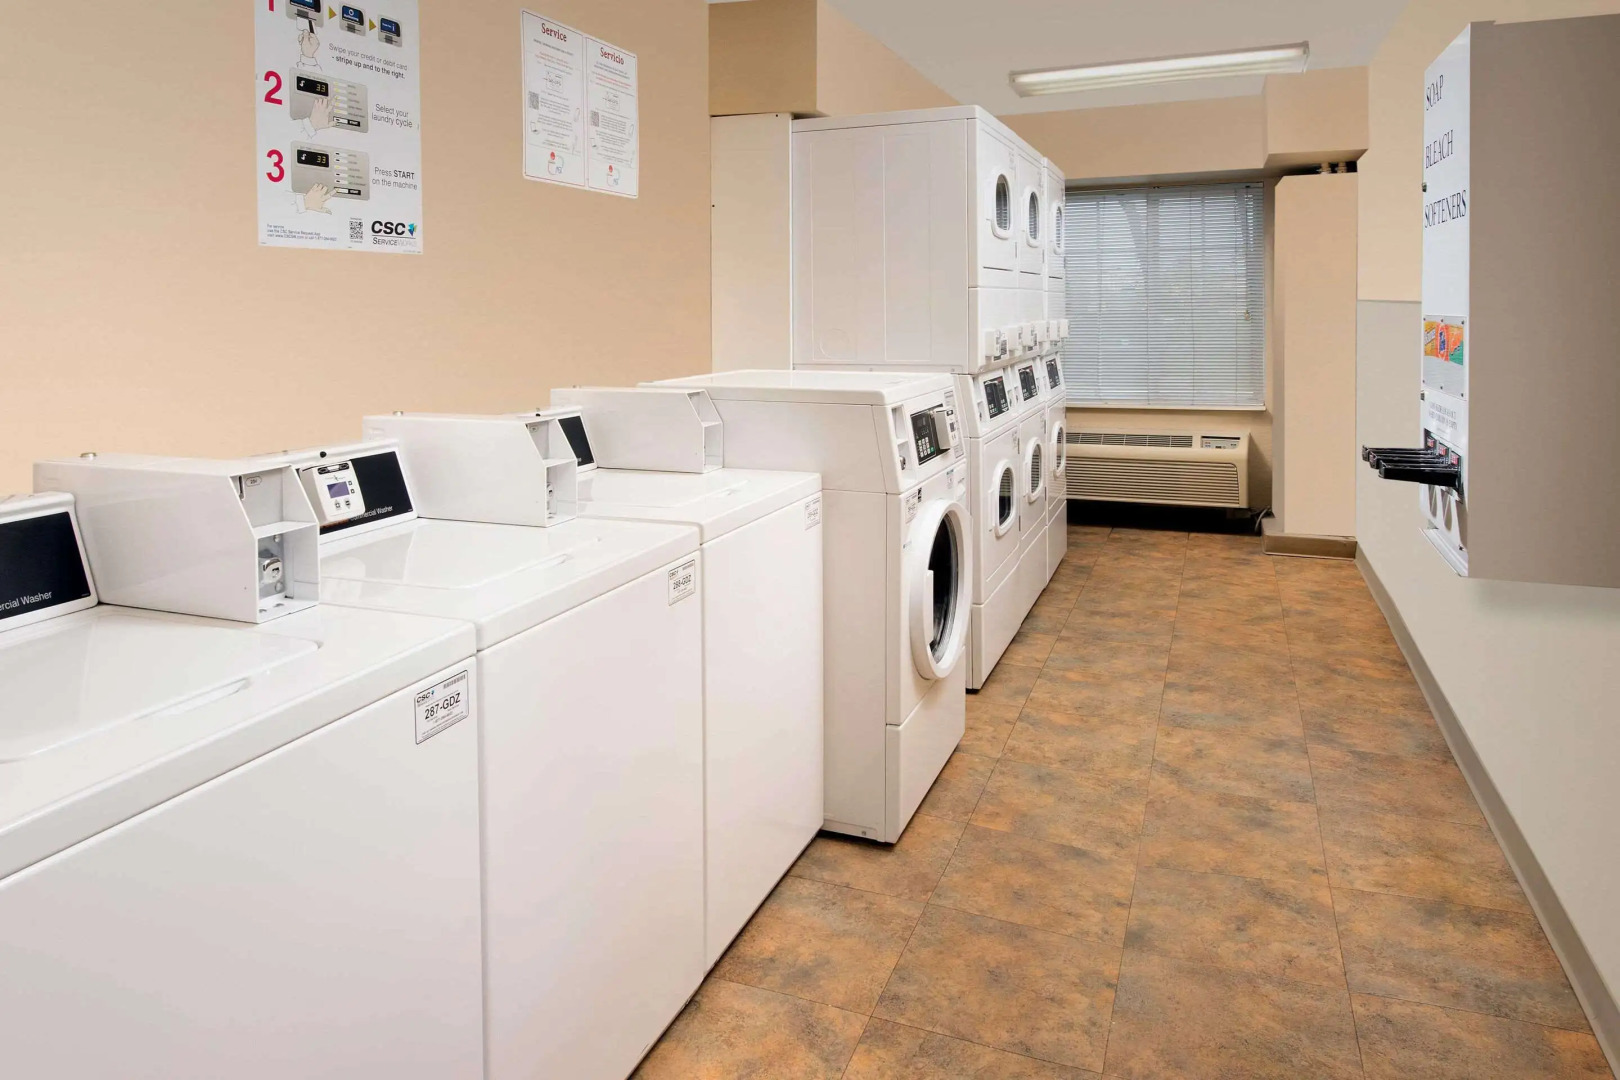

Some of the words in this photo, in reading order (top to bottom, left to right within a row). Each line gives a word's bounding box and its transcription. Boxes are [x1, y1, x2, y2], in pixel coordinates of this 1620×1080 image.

[541, 22, 567, 42] Service
[348, 48, 360, 57] your
[600, 47, 624, 65] Servicio
[336, 56, 352, 65] stripe
[264, 70, 283, 105] 2
[1426, 74, 1444, 111] SOAP
[376, 103, 395, 115] Select
[396, 110, 408, 118] your
[372, 112, 394, 126] laundry
[396, 118, 412, 128] cycle
[1426, 129, 1454, 169] BLEACH
[266, 148, 285, 182] 3
[374, 167, 392, 176] Press
[394, 170, 415, 180] START
[382, 178, 392, 186] the
[393, 181, 417, 190] machine
[1424, 190, 1467, 229] SOFTENERS
[371, 220, 406, 235] CSC
[376, 506, 393, 514] Washer
[20, 591, 52, 605] Washer
[416, 692, 430, 703] CSC
[424, 692, 461, 720] 287-GDZ
